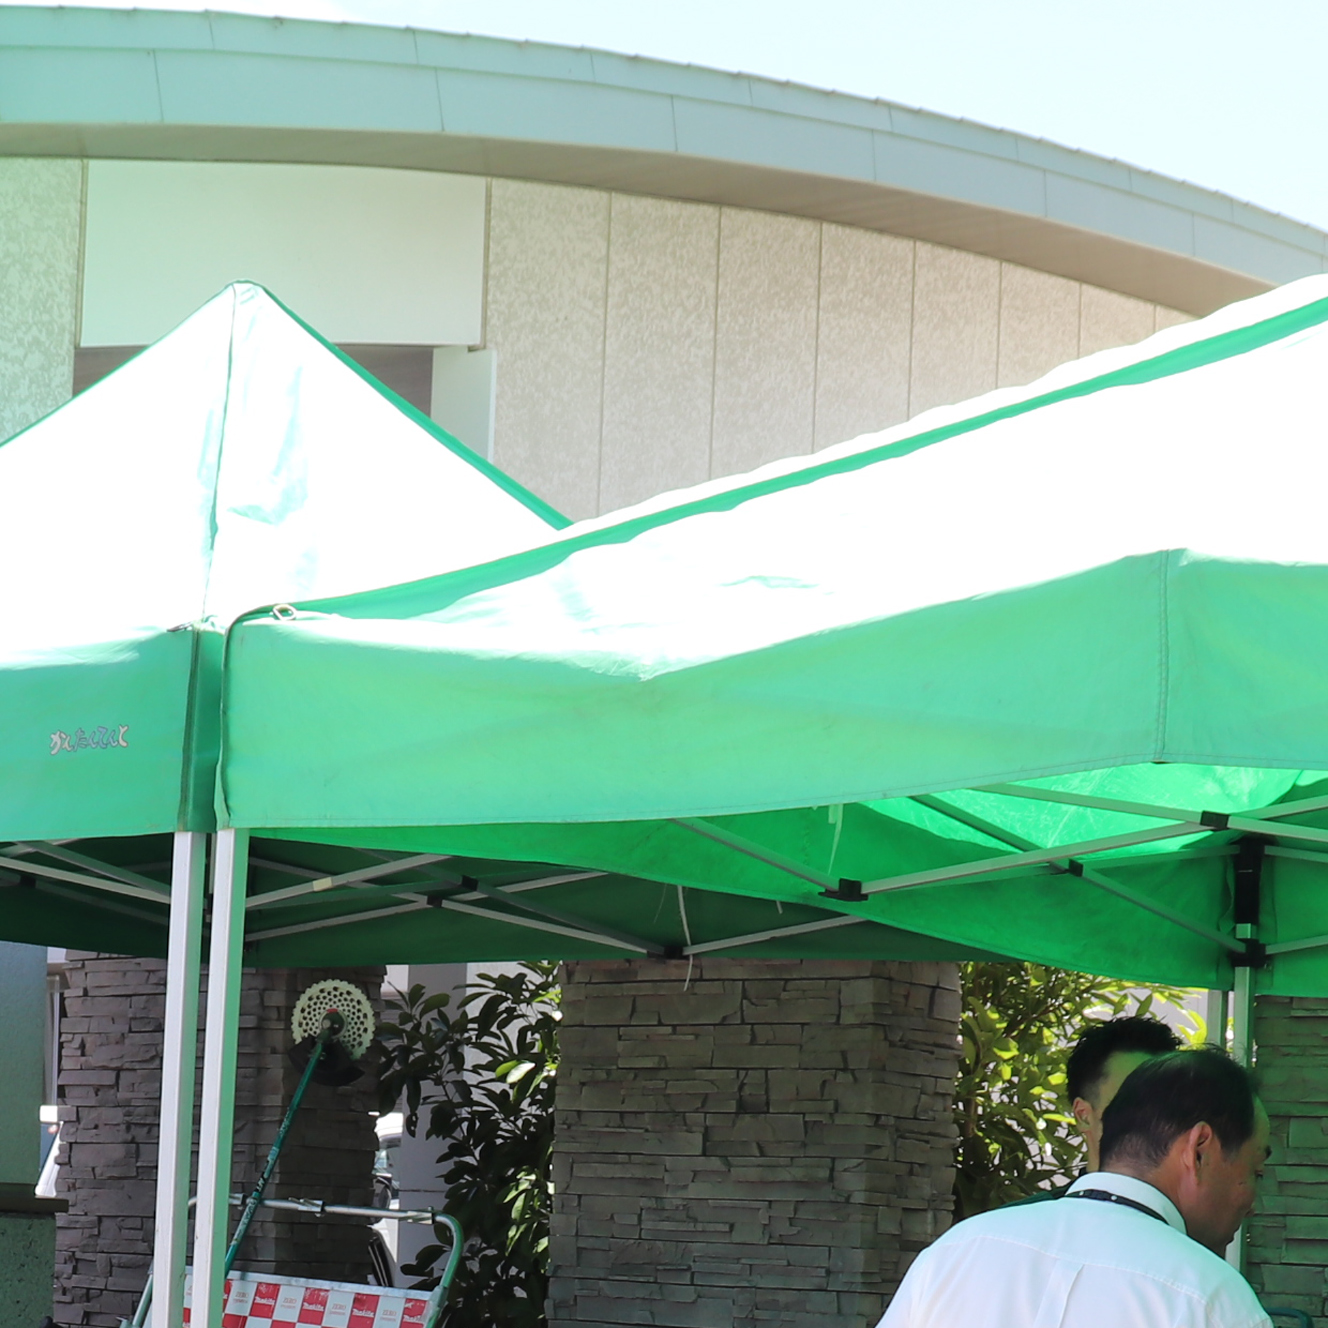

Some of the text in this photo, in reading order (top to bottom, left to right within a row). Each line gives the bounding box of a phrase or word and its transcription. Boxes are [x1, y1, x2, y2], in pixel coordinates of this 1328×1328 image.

[50, 725, 129, 756] かんたんてんと
